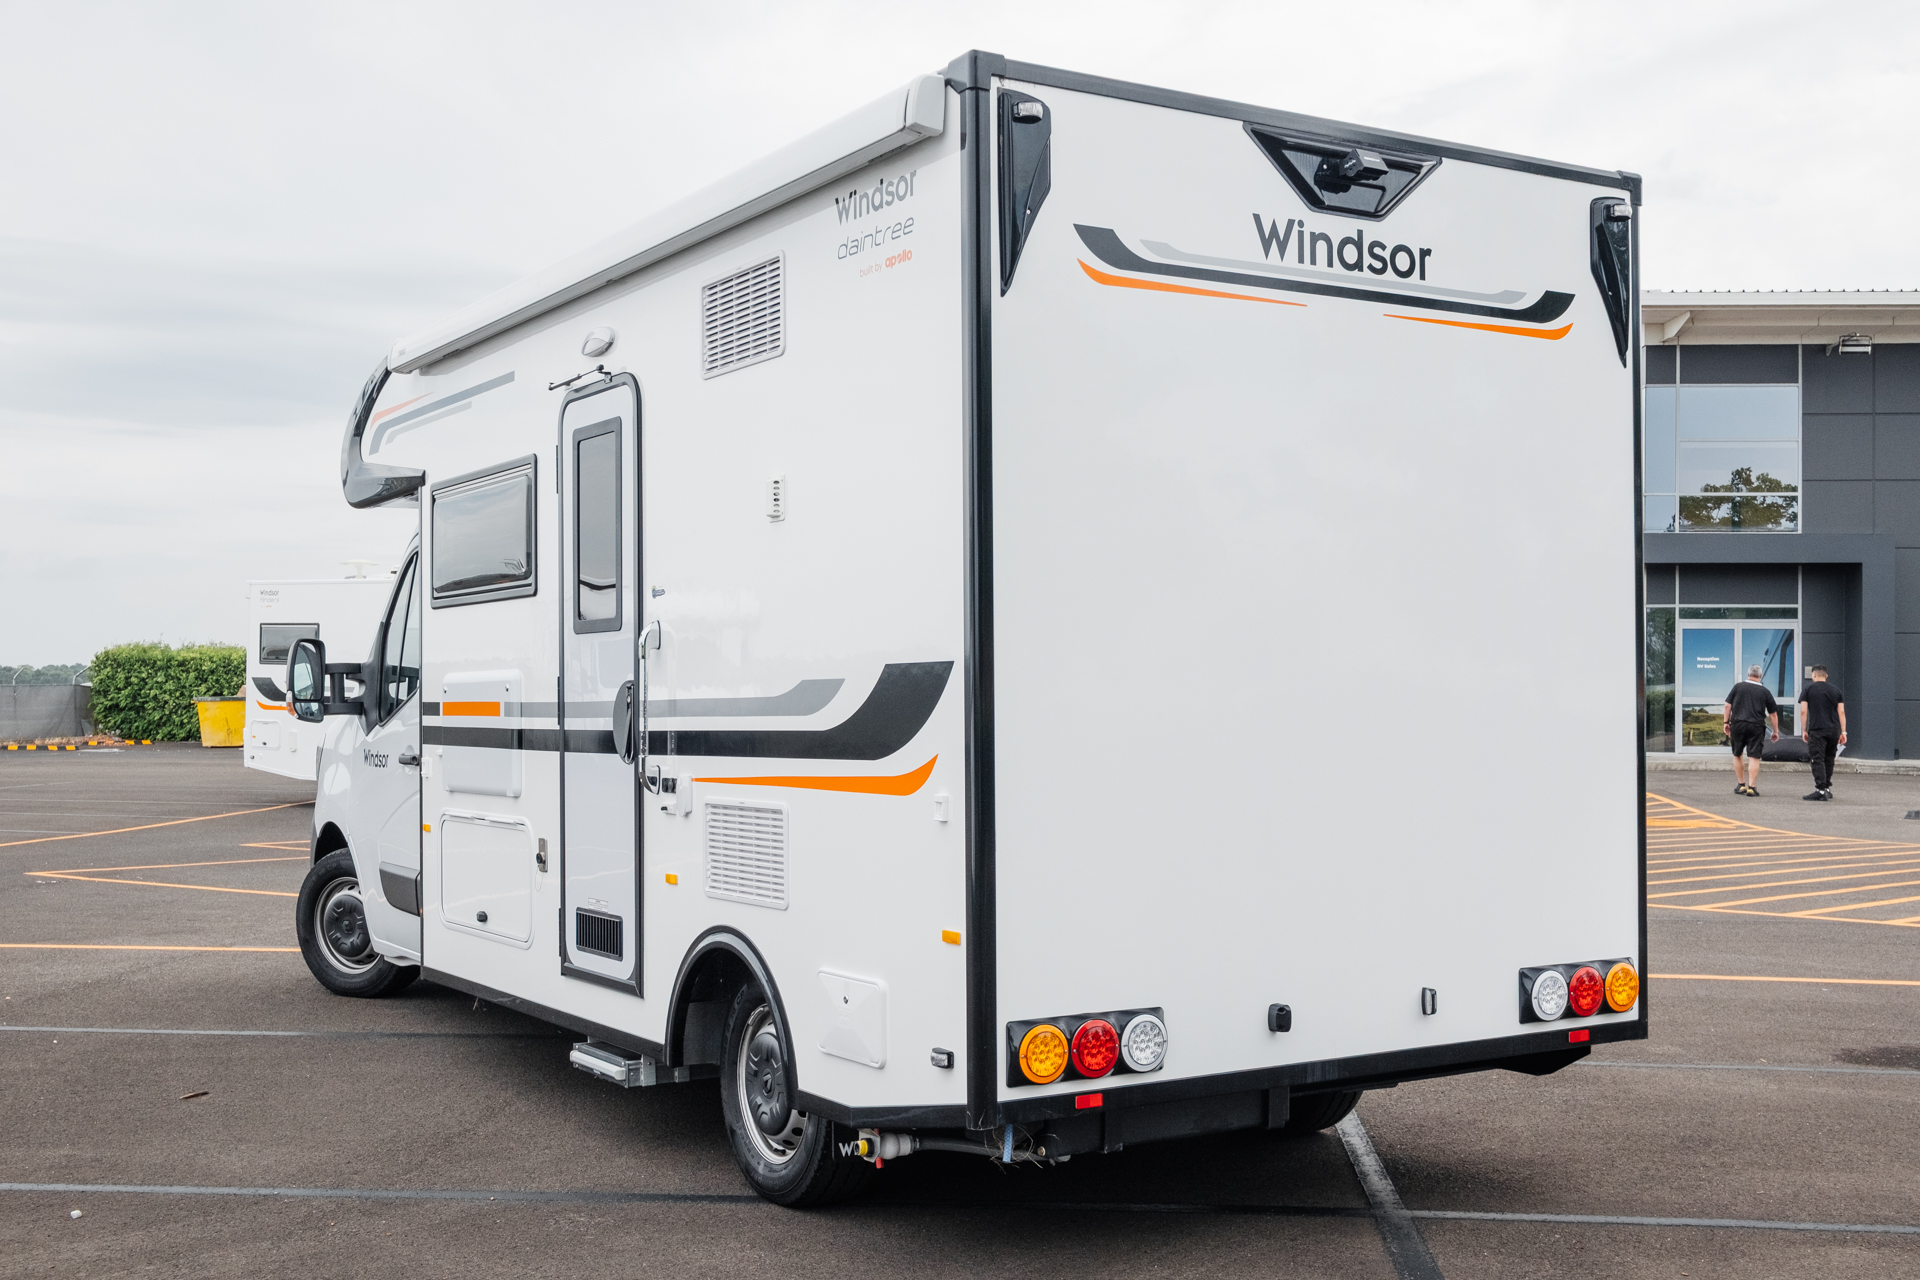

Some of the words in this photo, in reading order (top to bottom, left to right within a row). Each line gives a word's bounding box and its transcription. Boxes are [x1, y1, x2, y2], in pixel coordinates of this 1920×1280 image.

[834, 169, 917, 226] Windsor
[837, 217, 915, 260] daintree
[1252, 213, 1432, 281] Windsor
[859, 264, 874, 278] built
[875, 262, 883, 273] by
[884, 249, 913, 269] apollo
[259, 589, 280, 597] Windsor
[363, 748, 389, 768] Windsor
